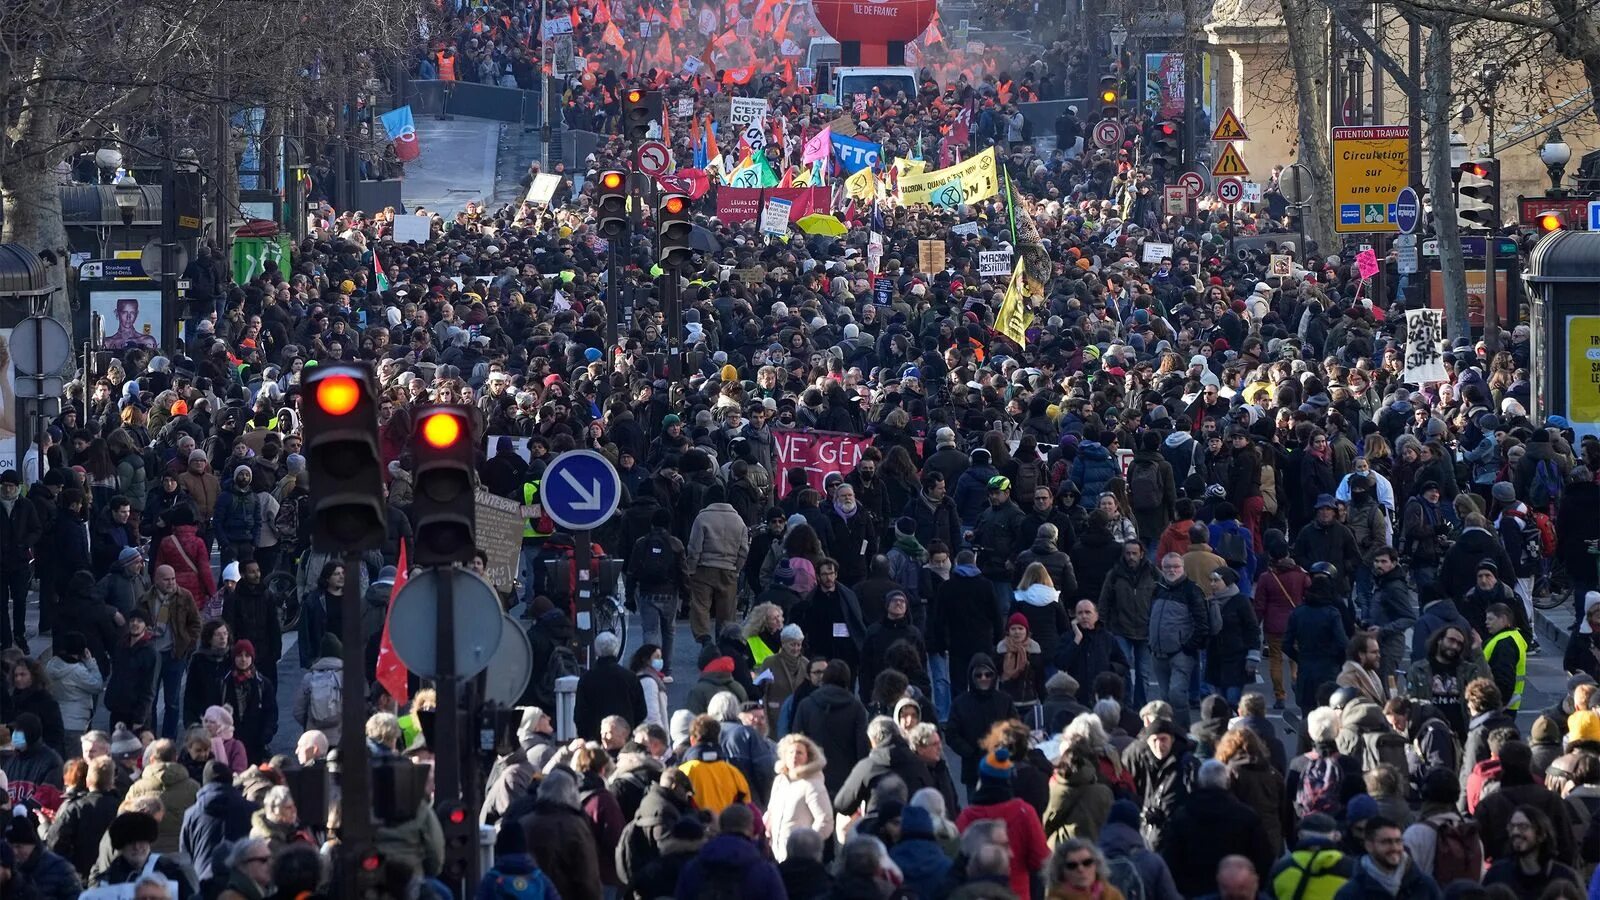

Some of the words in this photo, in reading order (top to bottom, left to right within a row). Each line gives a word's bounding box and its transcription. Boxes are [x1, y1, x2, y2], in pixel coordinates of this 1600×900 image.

[864, 5, 873, 15] DE
[873, 6, 898, 17] FRANCE
[734, 106, 763, 115] C'EST
[1335, 129, 1374, 139] ATTENTION
[1376, 129, 1409, 138] TRAVAUX
[1365, 169, 1382, 177] sur
[1223, 185, 1239, 197] 30
[1351, 186, 1370, 194] une
[1375, 184, 1397, 193] voie
[981, 253, 1010, 263] MACRON
